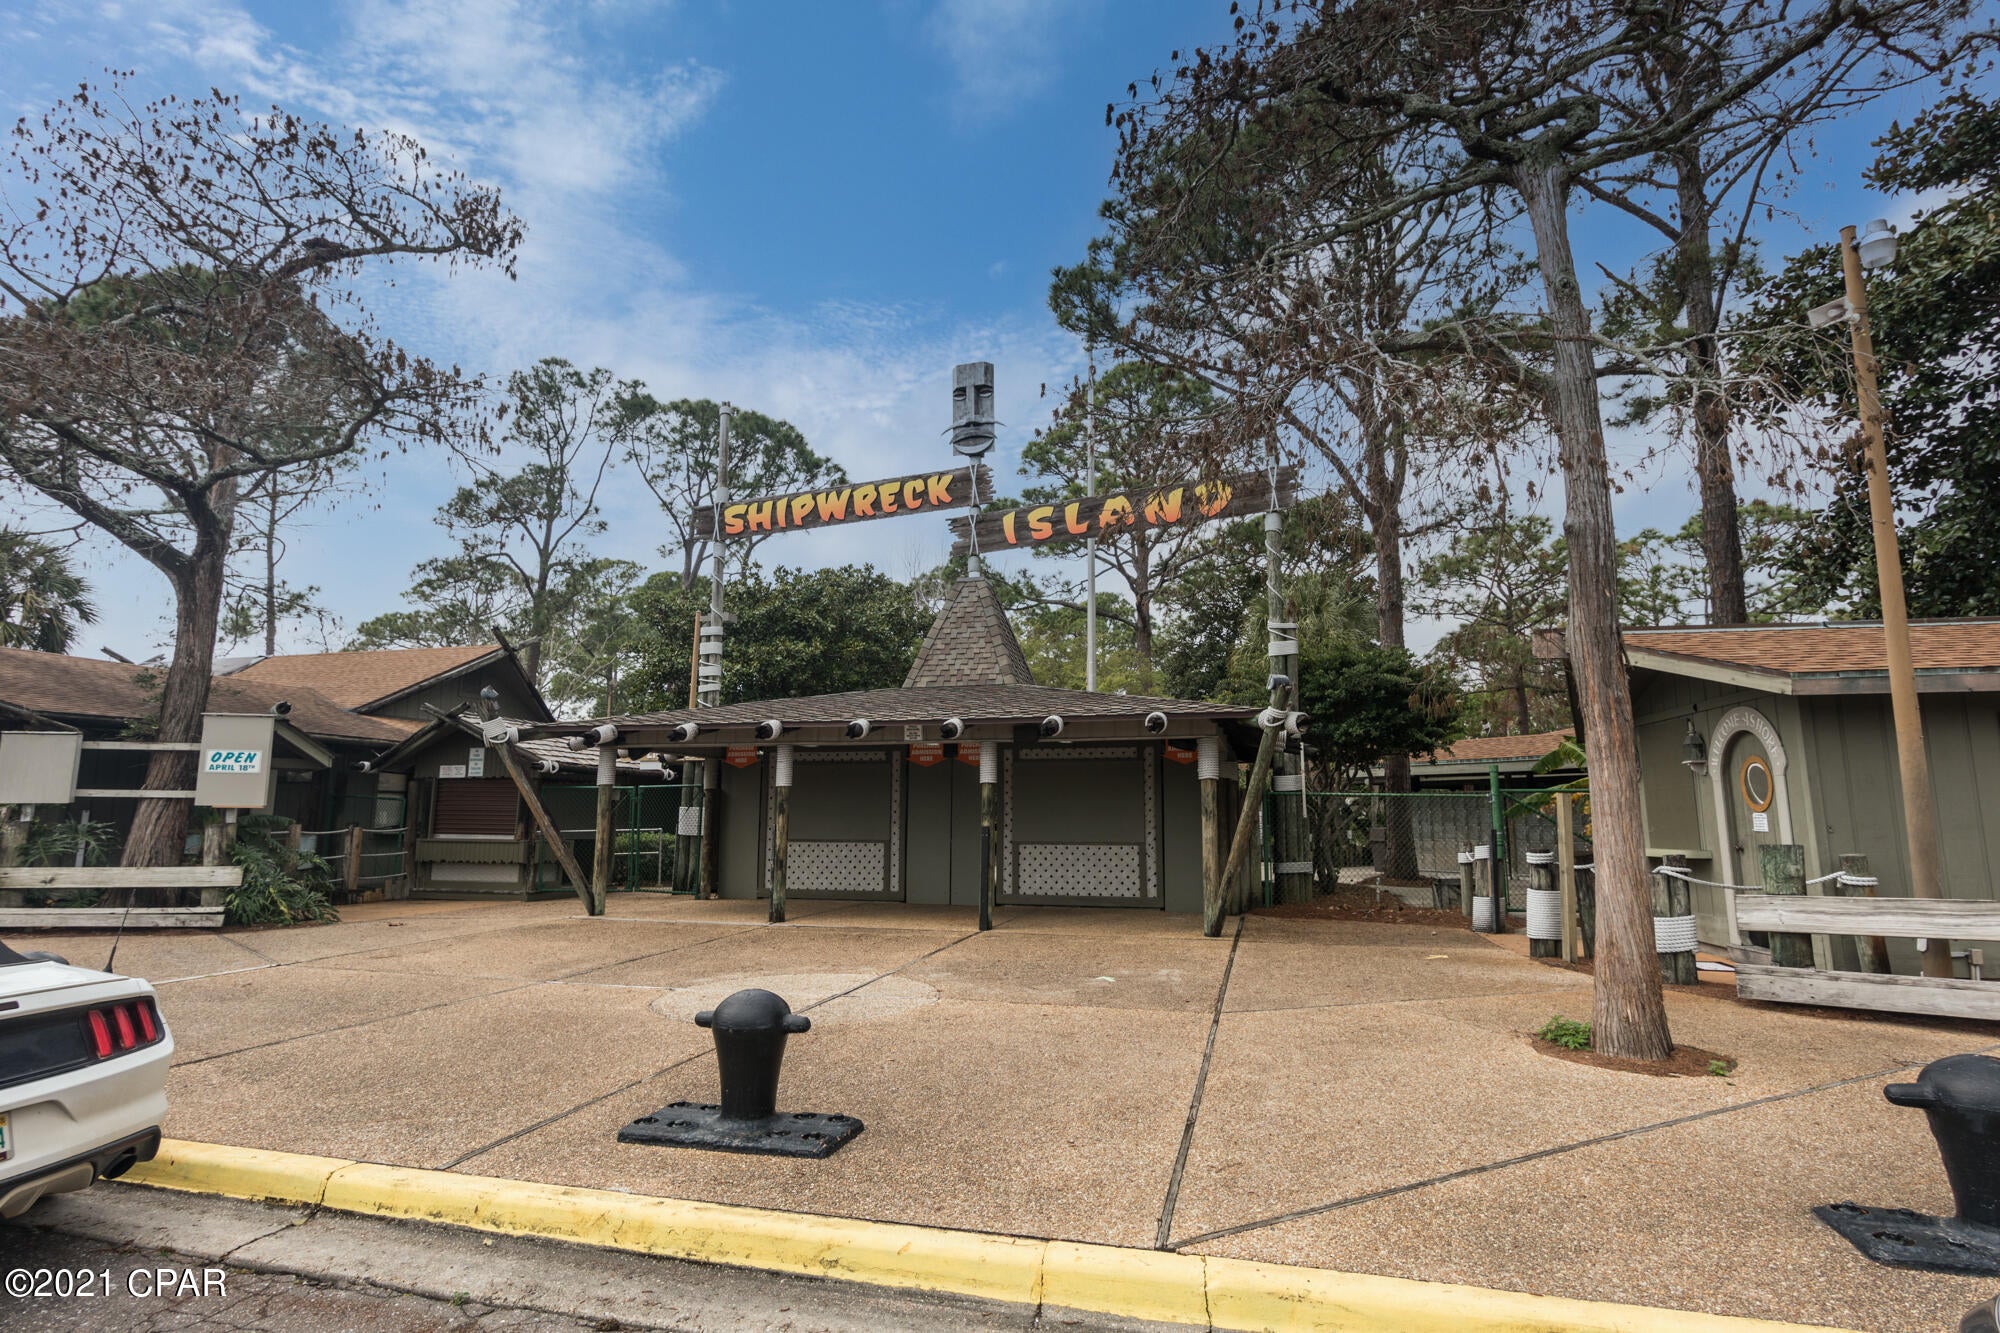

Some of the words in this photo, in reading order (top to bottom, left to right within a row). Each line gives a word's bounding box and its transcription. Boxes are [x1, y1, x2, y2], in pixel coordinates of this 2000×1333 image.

[724, 474, 954, 536] SHIPWRECK
[1002, 479, 1233, 545] ISLAND
[1742, 711, 1778, 756] ASHORE
[210, 752, 256, 763] OPEN
